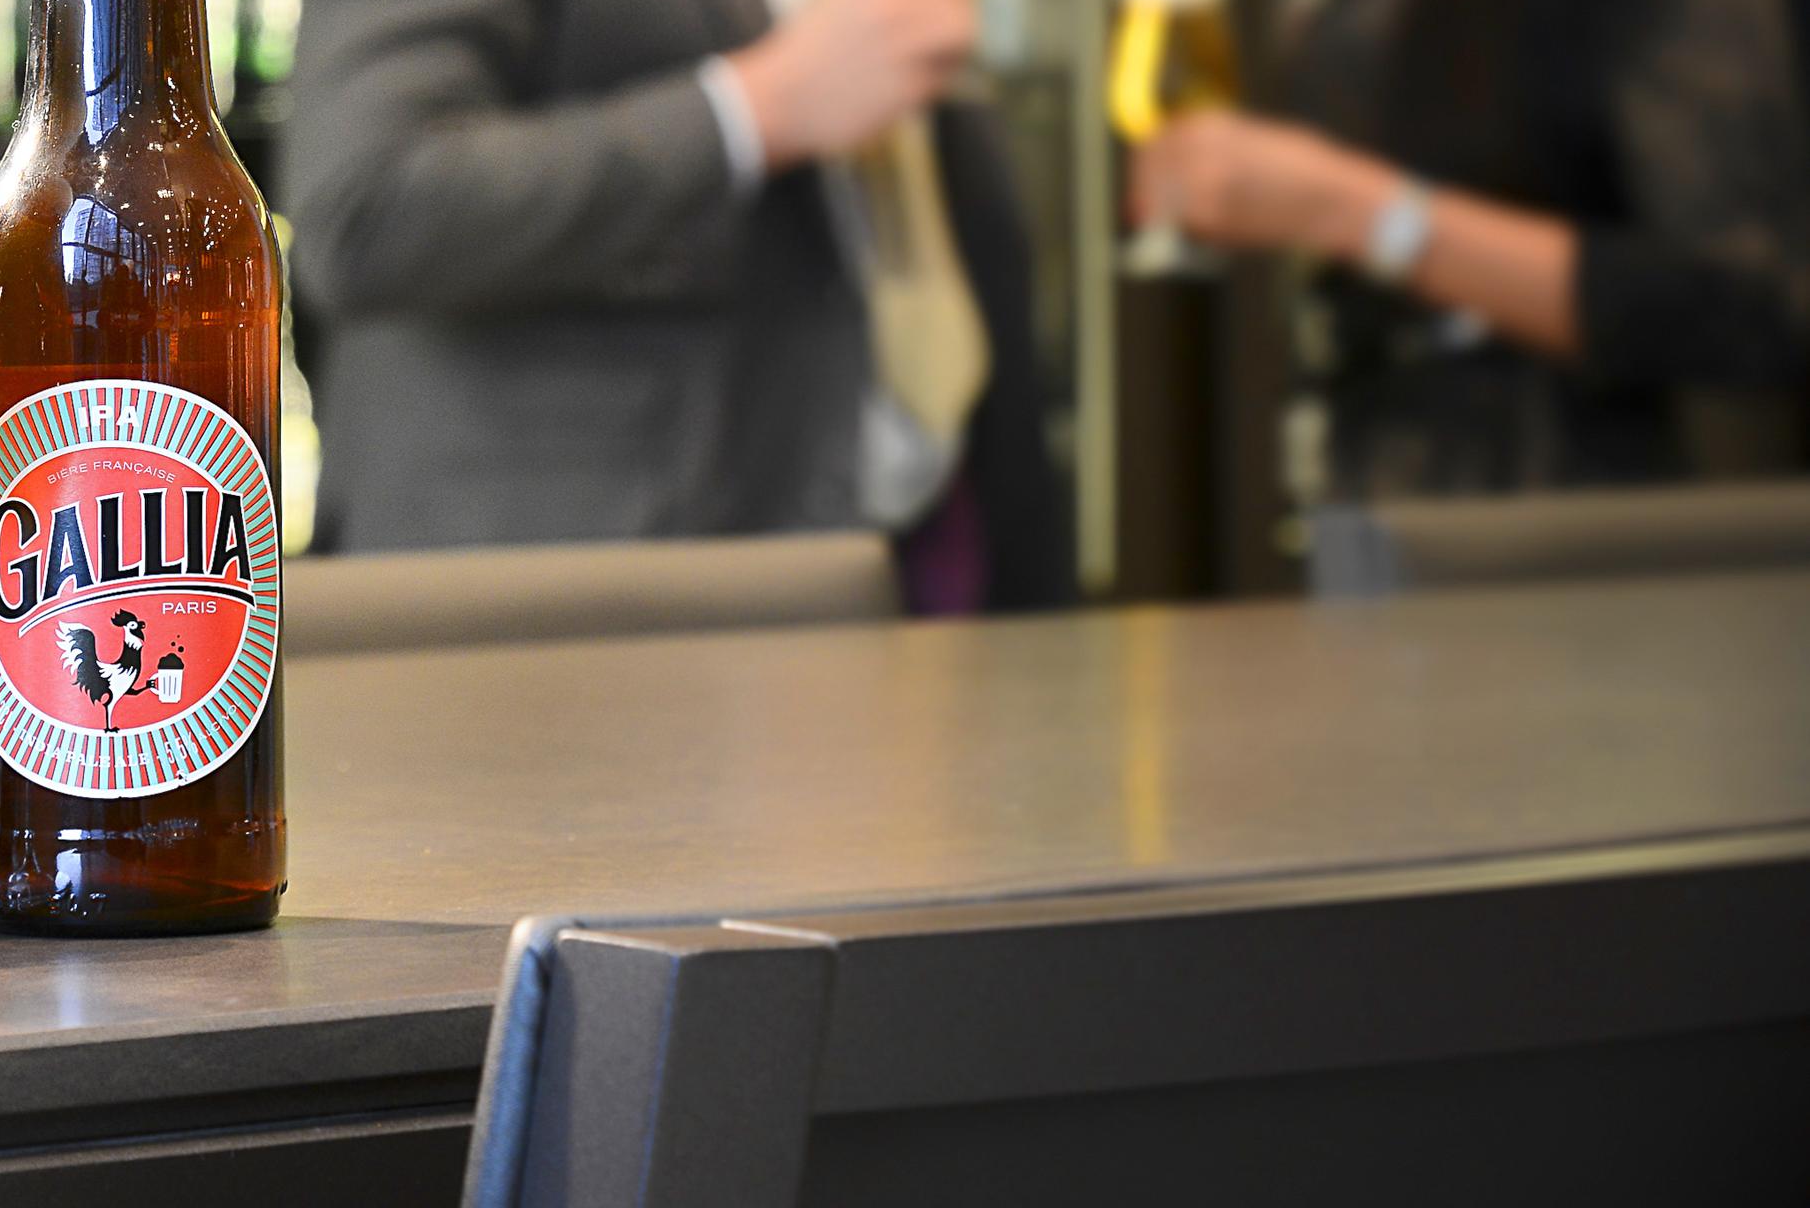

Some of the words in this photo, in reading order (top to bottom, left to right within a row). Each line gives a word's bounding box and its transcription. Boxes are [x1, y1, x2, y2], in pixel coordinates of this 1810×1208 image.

[77, 405, 140, 428] IPA
[47, 463, 88, 485] BIÈRE
[93, 460, 176, 484] FRANÇAISE
[161, 600, 217, 615] PARIS
